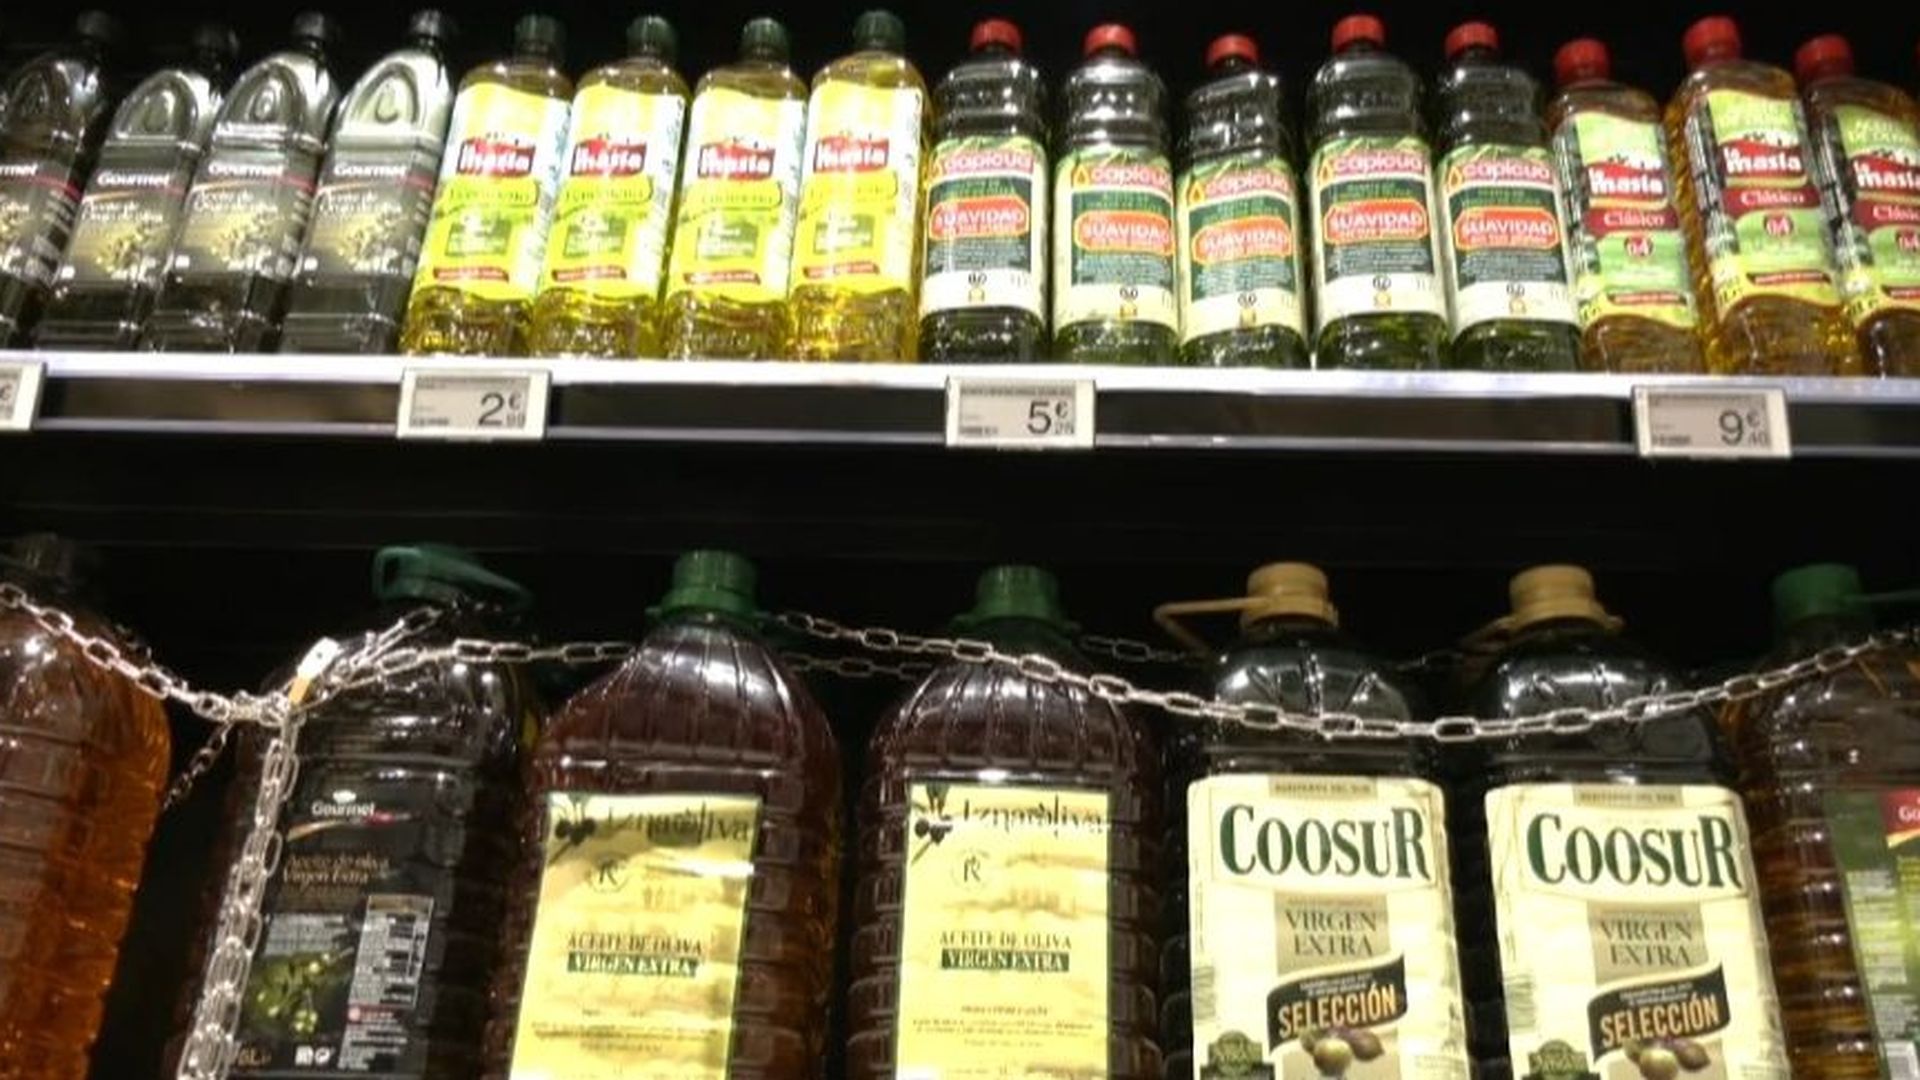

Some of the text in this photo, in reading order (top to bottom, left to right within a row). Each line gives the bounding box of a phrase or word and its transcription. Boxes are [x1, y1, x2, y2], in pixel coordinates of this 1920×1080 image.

[209, 162, 284, 177] Gourmet
[334, 163, 407, 177] Gourmet
[1728, 153, 1800, 174] masia
[97, 171, 170, 186] Gourmet
[1592, 174, 1663, 195] masia
[1741, 190, 1804, 207] Clásico
[1331, 209, 1421, 230] SUAVIDAD
[1463, 218, 1552, 238] SUAVIDAD
[478, 391, 505, 426] 2
[1027, 400, 1068, 435] 5 €
[1719, 409, 1744, 445] 9
[312, 802, 375, 817] Gourmet
[1220, 803, 1432, 882] COOSUR
[1526, 812, 1744, 890] COOSUR
[1284, 908, 1378, 933] VIRGEN
[1599, 918, 1695, 942] VIRGEN
[568, 932, 703, 956] ACEITE DE OLIVA
[940, 930, 1073, 950] ACEITE DE OLIVA
[1294, 933, 1375, 958] EXTRA
[574, 953, 693, 977] VIRGEN EXTRA
[947, 951, 1065, 972] VIRGEN EXTRA
[1609, 944, 1693, 968] EXTRA
[1278, 980, 1397, 1039] SELECCIÓN
[1601, 990, 1720, 1048] SELECCIÓN
